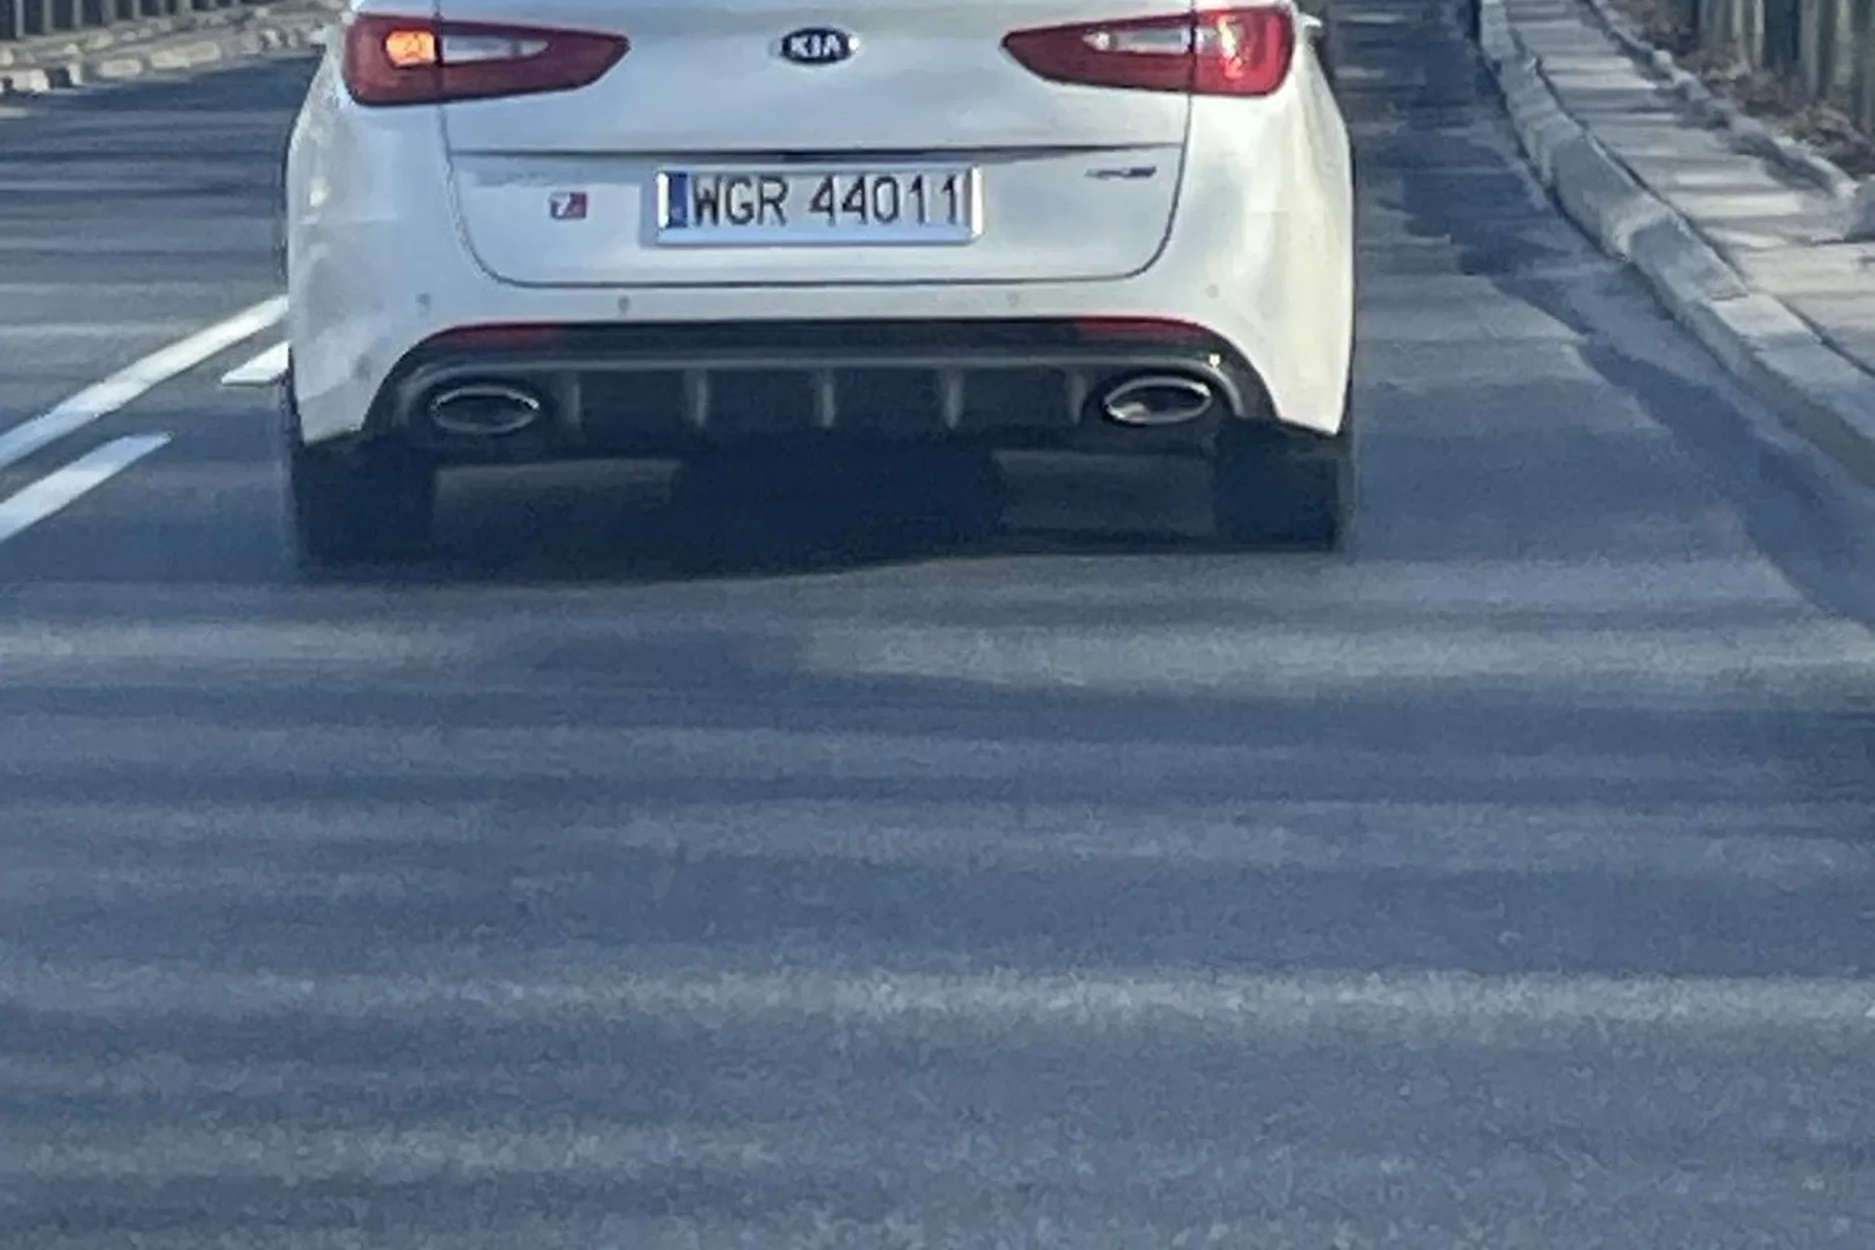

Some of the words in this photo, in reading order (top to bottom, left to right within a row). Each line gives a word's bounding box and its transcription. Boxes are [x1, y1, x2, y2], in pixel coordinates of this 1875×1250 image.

[791, 34, 841, 58] KIA
[692, 174, 789, 227] WGR
[808, 173, 960, 227] 44011
